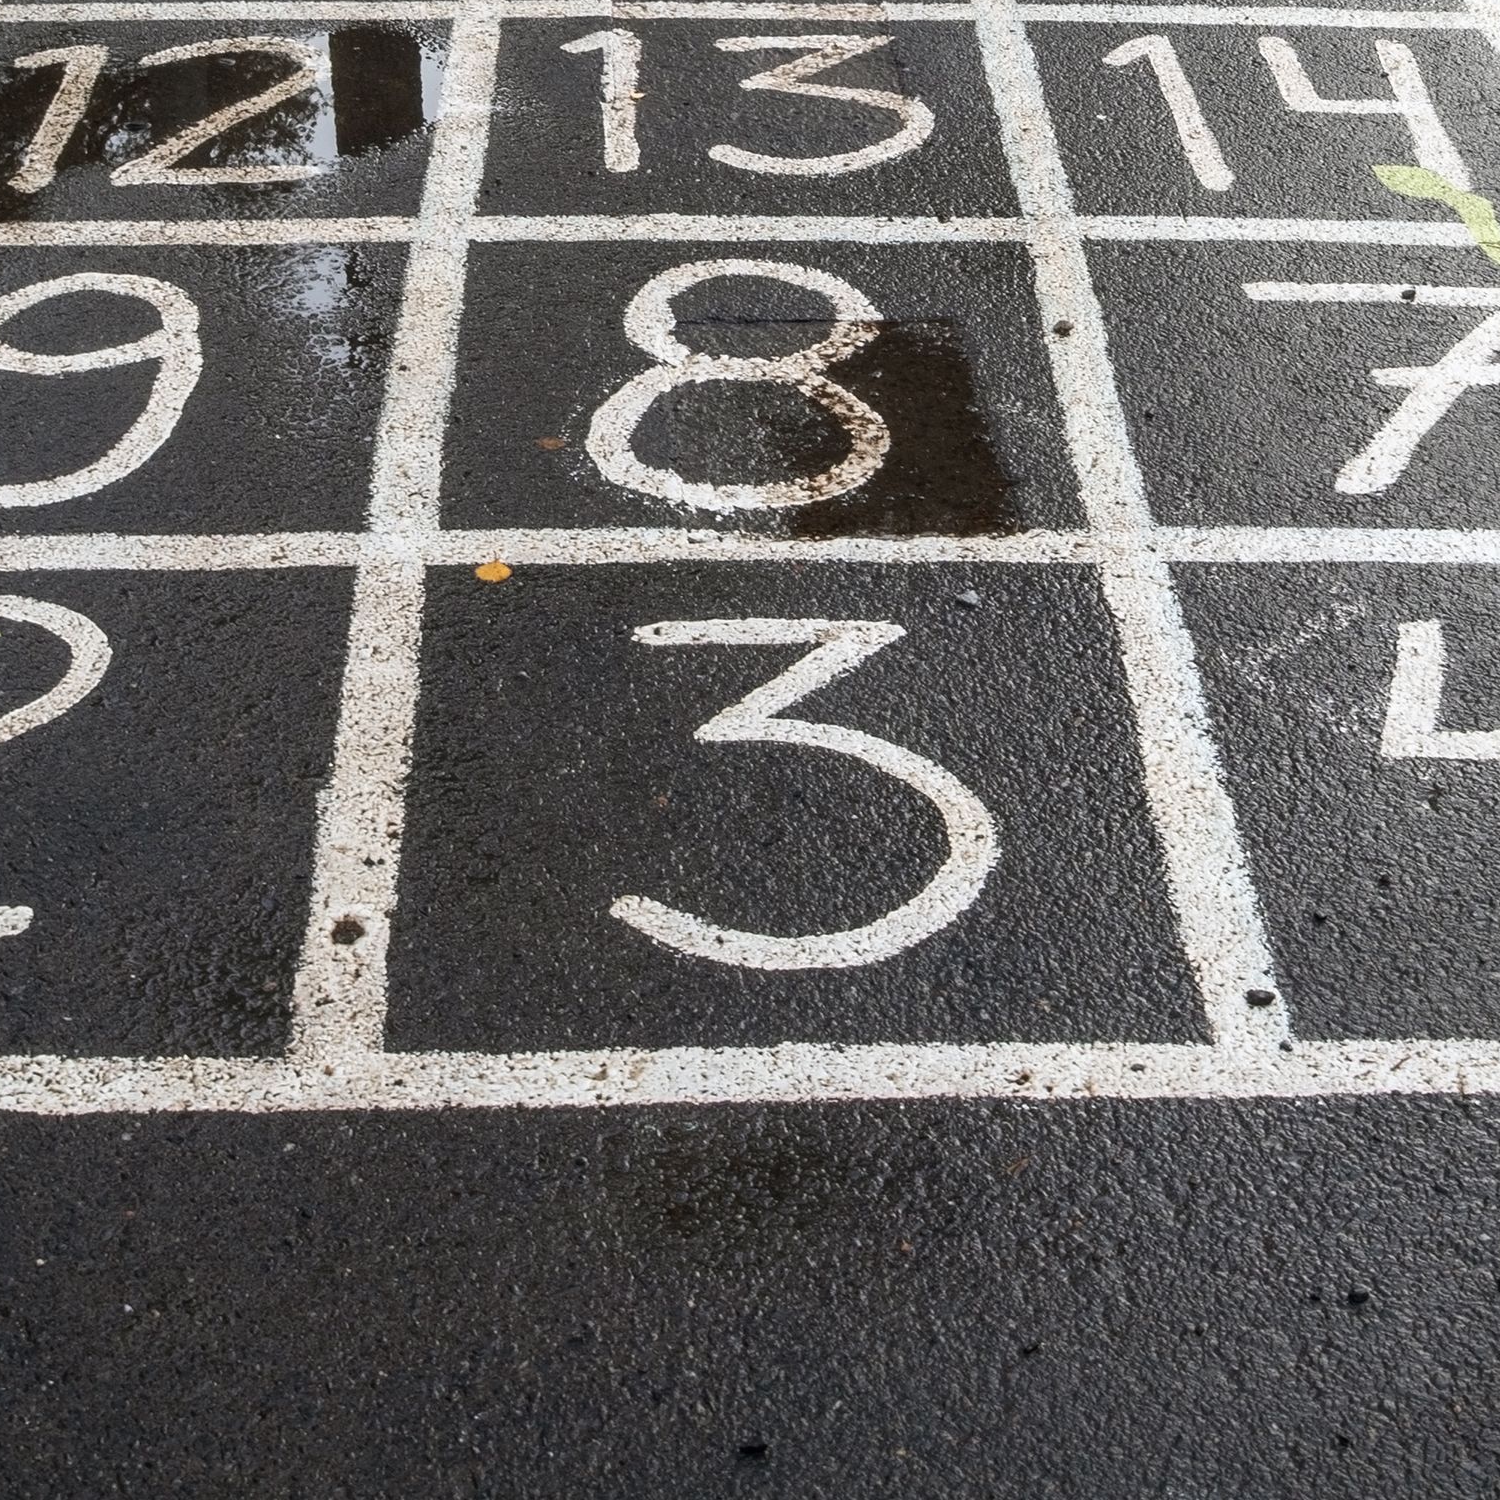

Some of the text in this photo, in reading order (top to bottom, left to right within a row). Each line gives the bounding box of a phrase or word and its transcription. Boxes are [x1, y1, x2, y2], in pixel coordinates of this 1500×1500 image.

[6, 36, 332, 194] 12
[560, 28, 936, 175] 13
[1103, 33, 1473, 193] 14
[586, 257, 890, 509] 8
[610, 617, 999, 970] 3
